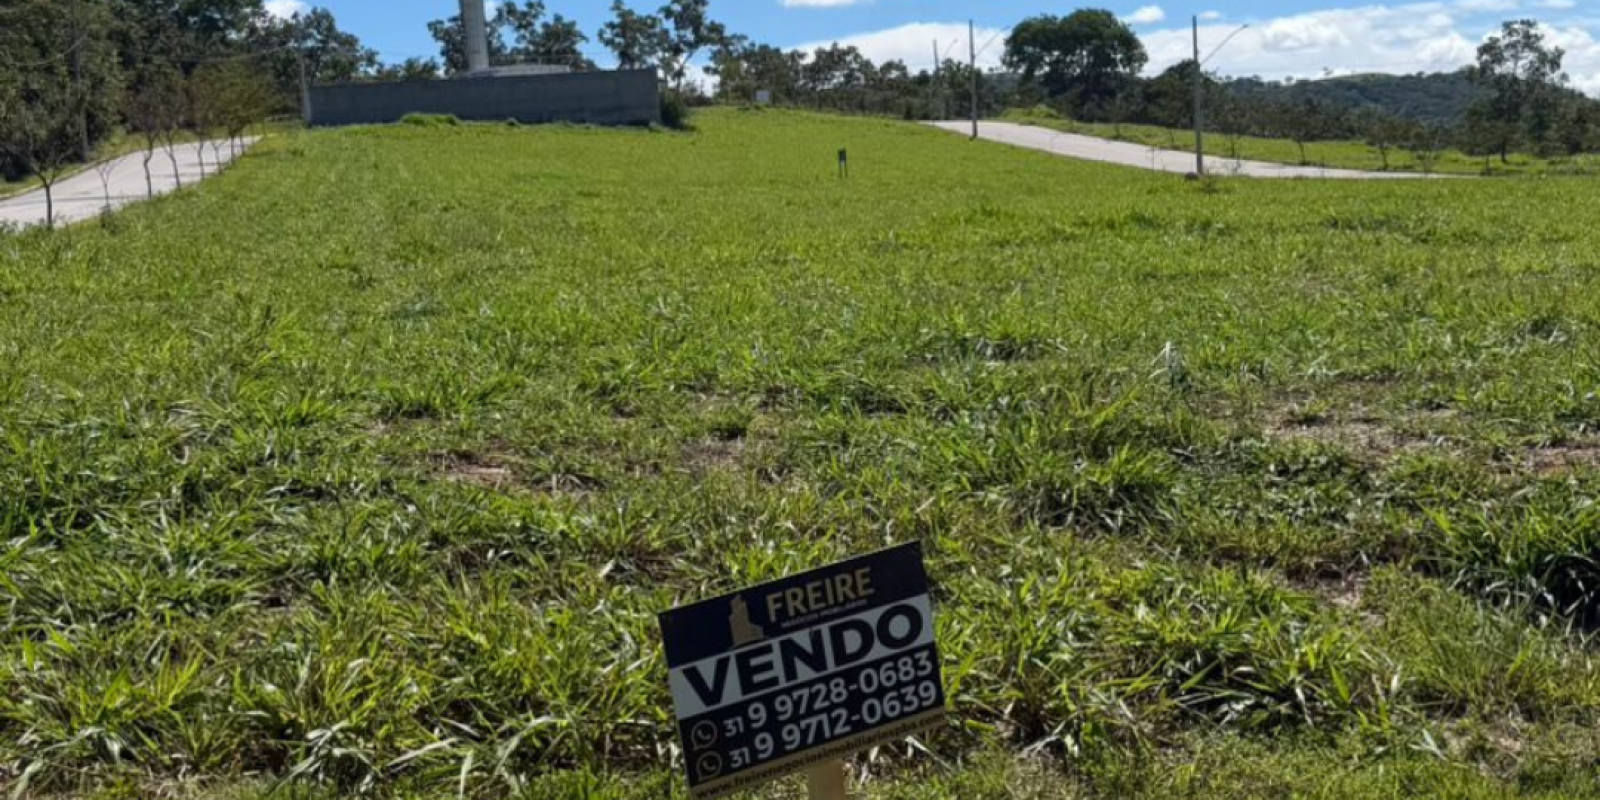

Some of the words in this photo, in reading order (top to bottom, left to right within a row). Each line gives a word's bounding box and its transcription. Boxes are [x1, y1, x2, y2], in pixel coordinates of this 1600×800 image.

[766, 566, 875, 622] FREIRE
[682, 603, 924, 708] VENDO
[723, 716, 745, 737] 31
[747, 702, 767, 728] 9
[774, 651, 933, 721] 9728-0683
[729, 747, 751, 768] 31
[754, 732, 774, 759] 9
[781, 680, 937, 750] 9712-0639
